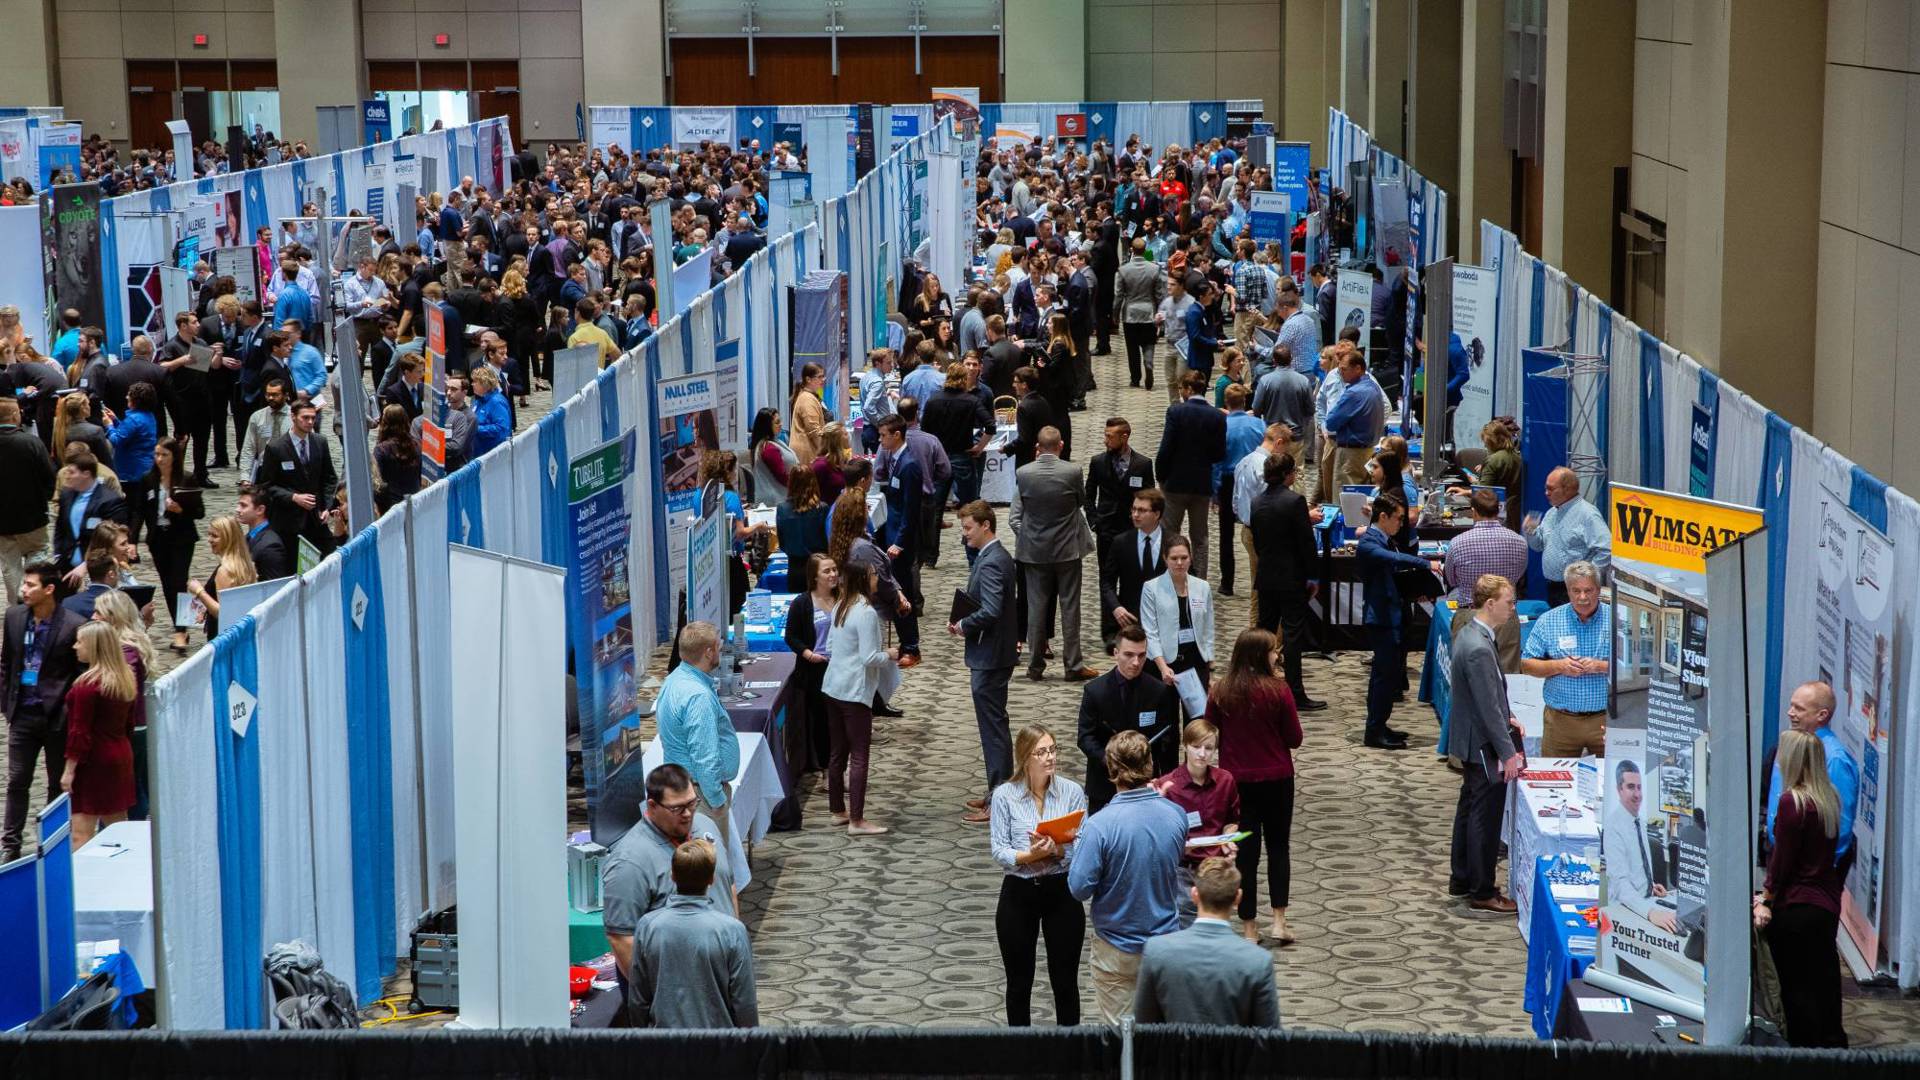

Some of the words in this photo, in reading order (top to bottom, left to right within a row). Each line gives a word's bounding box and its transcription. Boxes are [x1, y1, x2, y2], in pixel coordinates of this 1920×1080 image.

[686, 128, 726, 136] ADIENT
[58, 207, 96, 224] COYOTE
[1342, 280, 1369, 295] ArtiFlex
[664, 384, 686, 400] MILL
[687, 380, 710, 395] STEEL
[573, 457, 604, 488] TUBELITE
[1653, 541, 1698, 558] BUILDING
[1650, 678, 1680, 691] Professional
[1649, 689, 1677, 700] showrooms
[232, 702, 247, 721] J23
[1670, 701, 1695, 714] branches
[1667, 711, 1675, 719] the
[1676, 713, 1695, 723] perfect
[1648, 718, 1680, 730] environment
[1681, 723, 1689, 731] for
[1661, 730, 1673, 739] your
[1660, 738, 1680, 749] product
[1611, 919, 1636, 938] Your
[1638, 928, 1680, 953] Trusted
[1611, 936, 1651, 959] Partner
